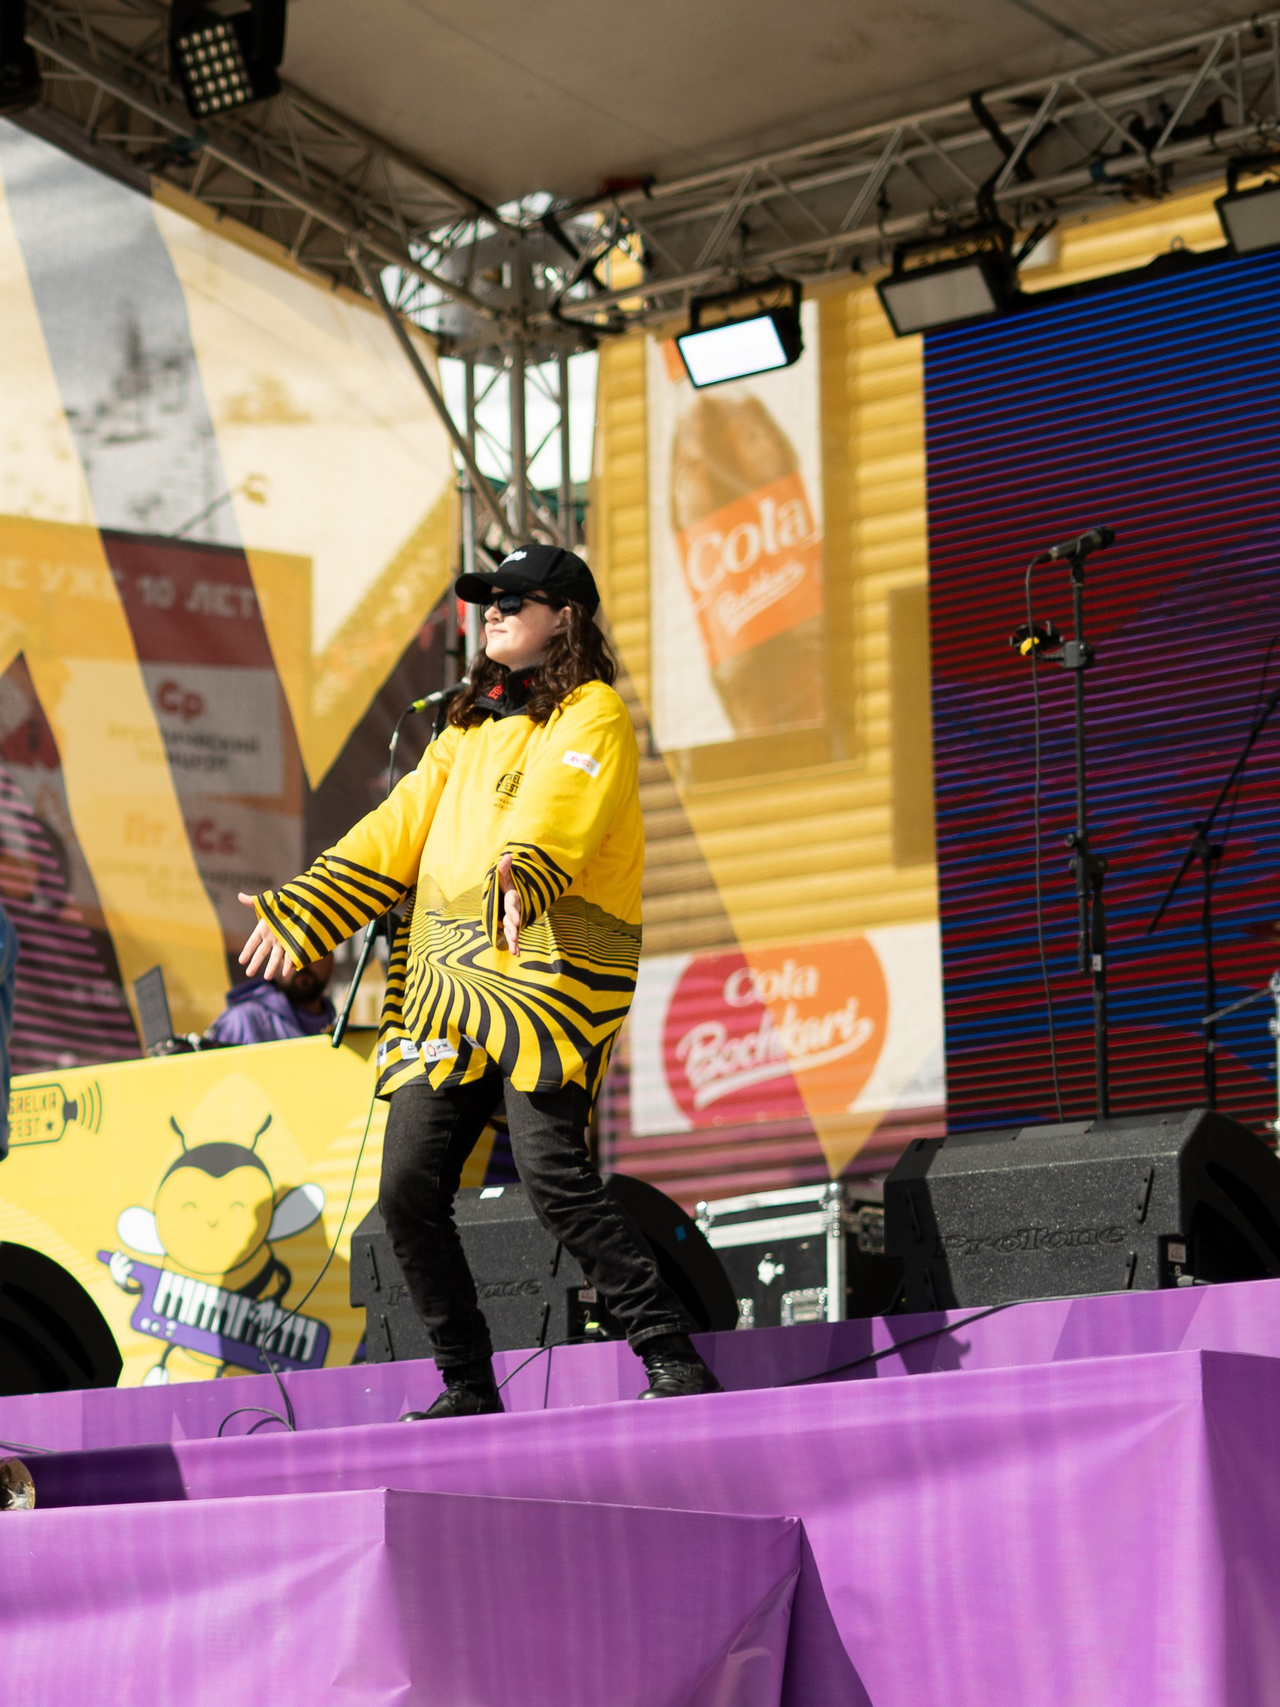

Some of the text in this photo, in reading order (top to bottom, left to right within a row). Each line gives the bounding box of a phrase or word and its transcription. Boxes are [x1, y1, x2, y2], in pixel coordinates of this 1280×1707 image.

[687, 497, 808, 592] Cola
[136, 574, 176, 609] 10
[723, 959, 818, 1008] Cola
[675, 997, 870, 1100] Bochkari
